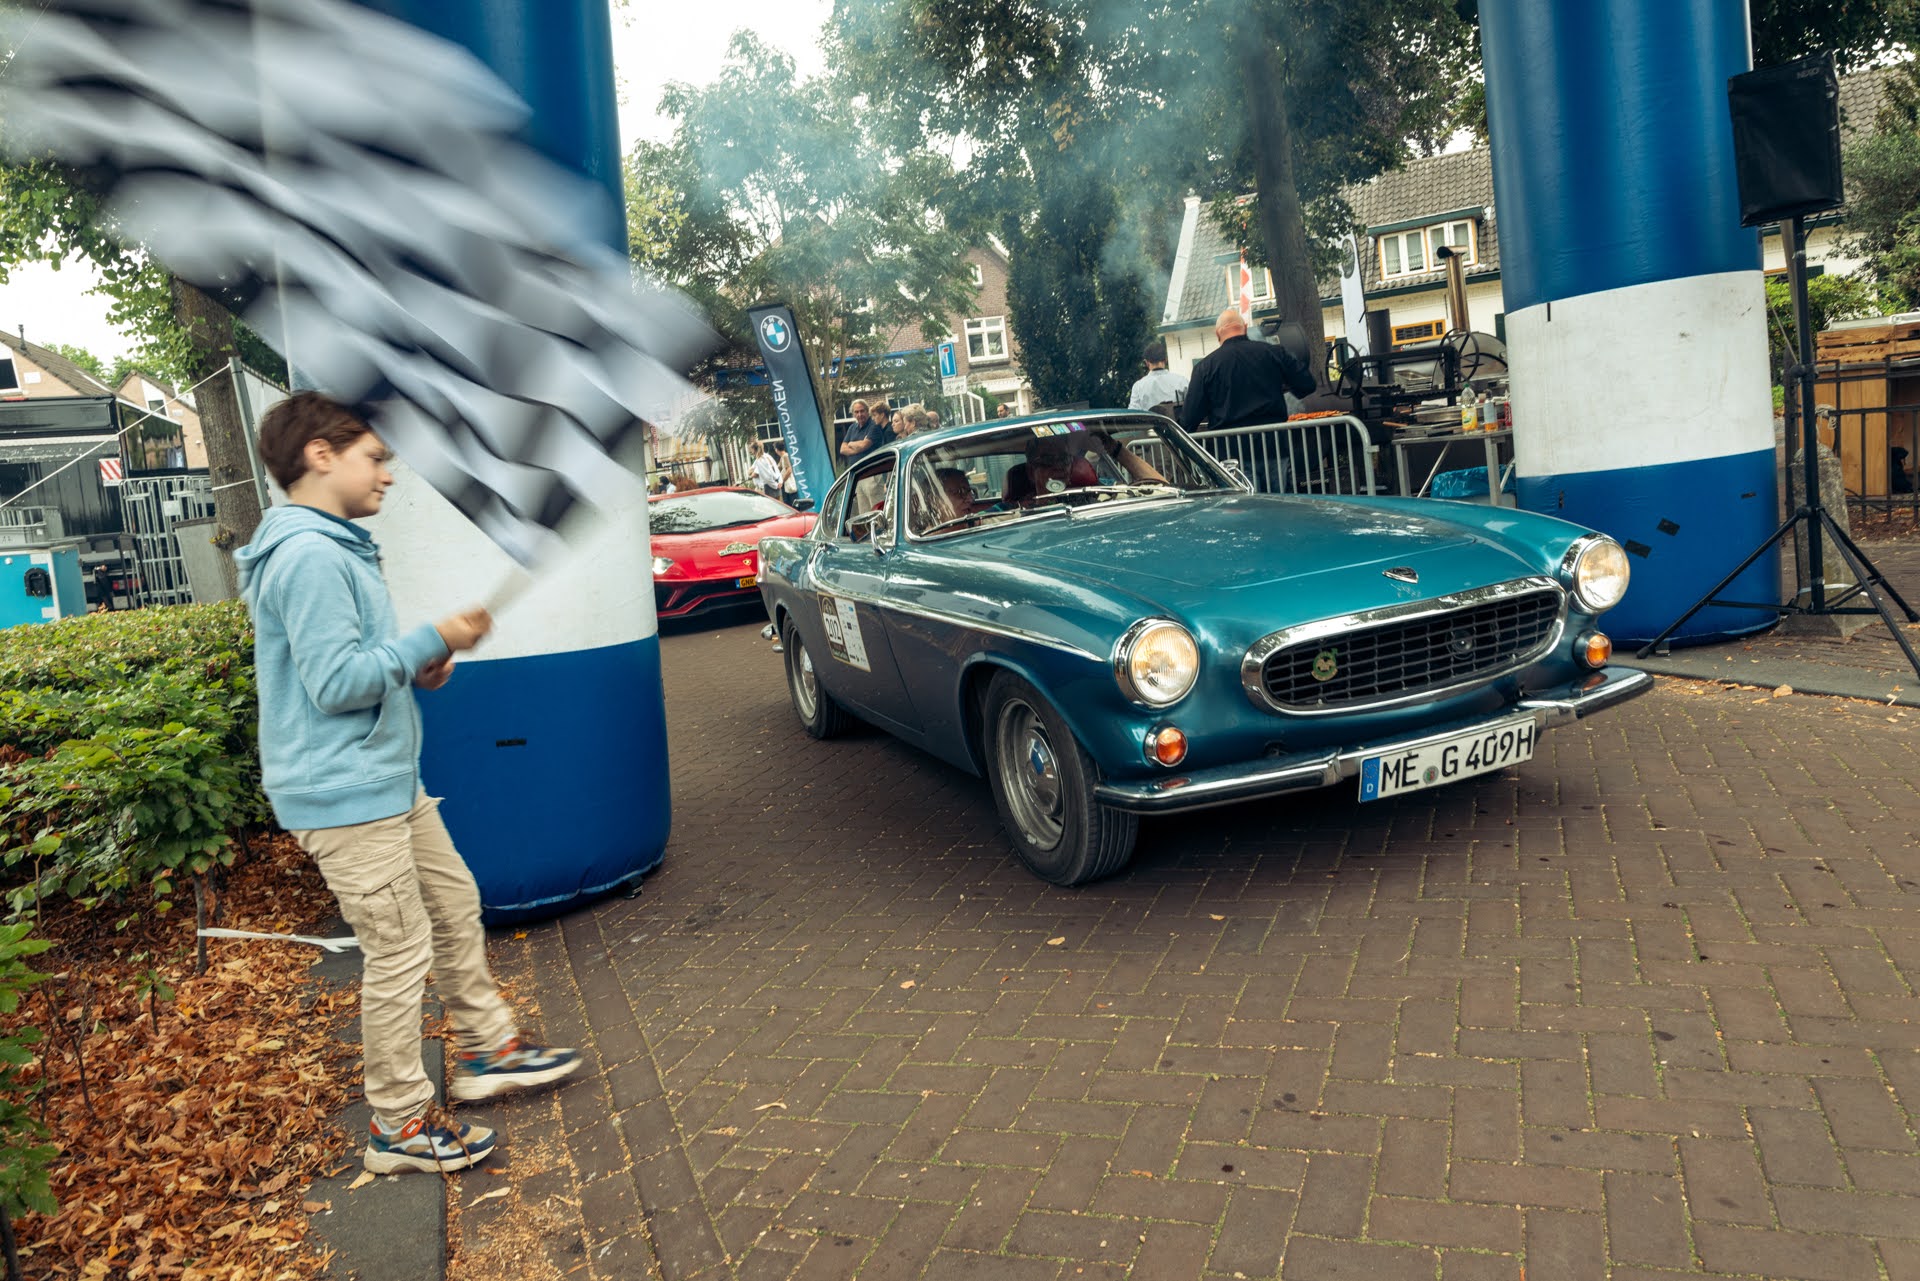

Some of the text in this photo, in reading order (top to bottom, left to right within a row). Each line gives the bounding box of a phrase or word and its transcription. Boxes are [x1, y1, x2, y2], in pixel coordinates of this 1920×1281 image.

[1366, 725, 1533, 793] D ME G 409H
